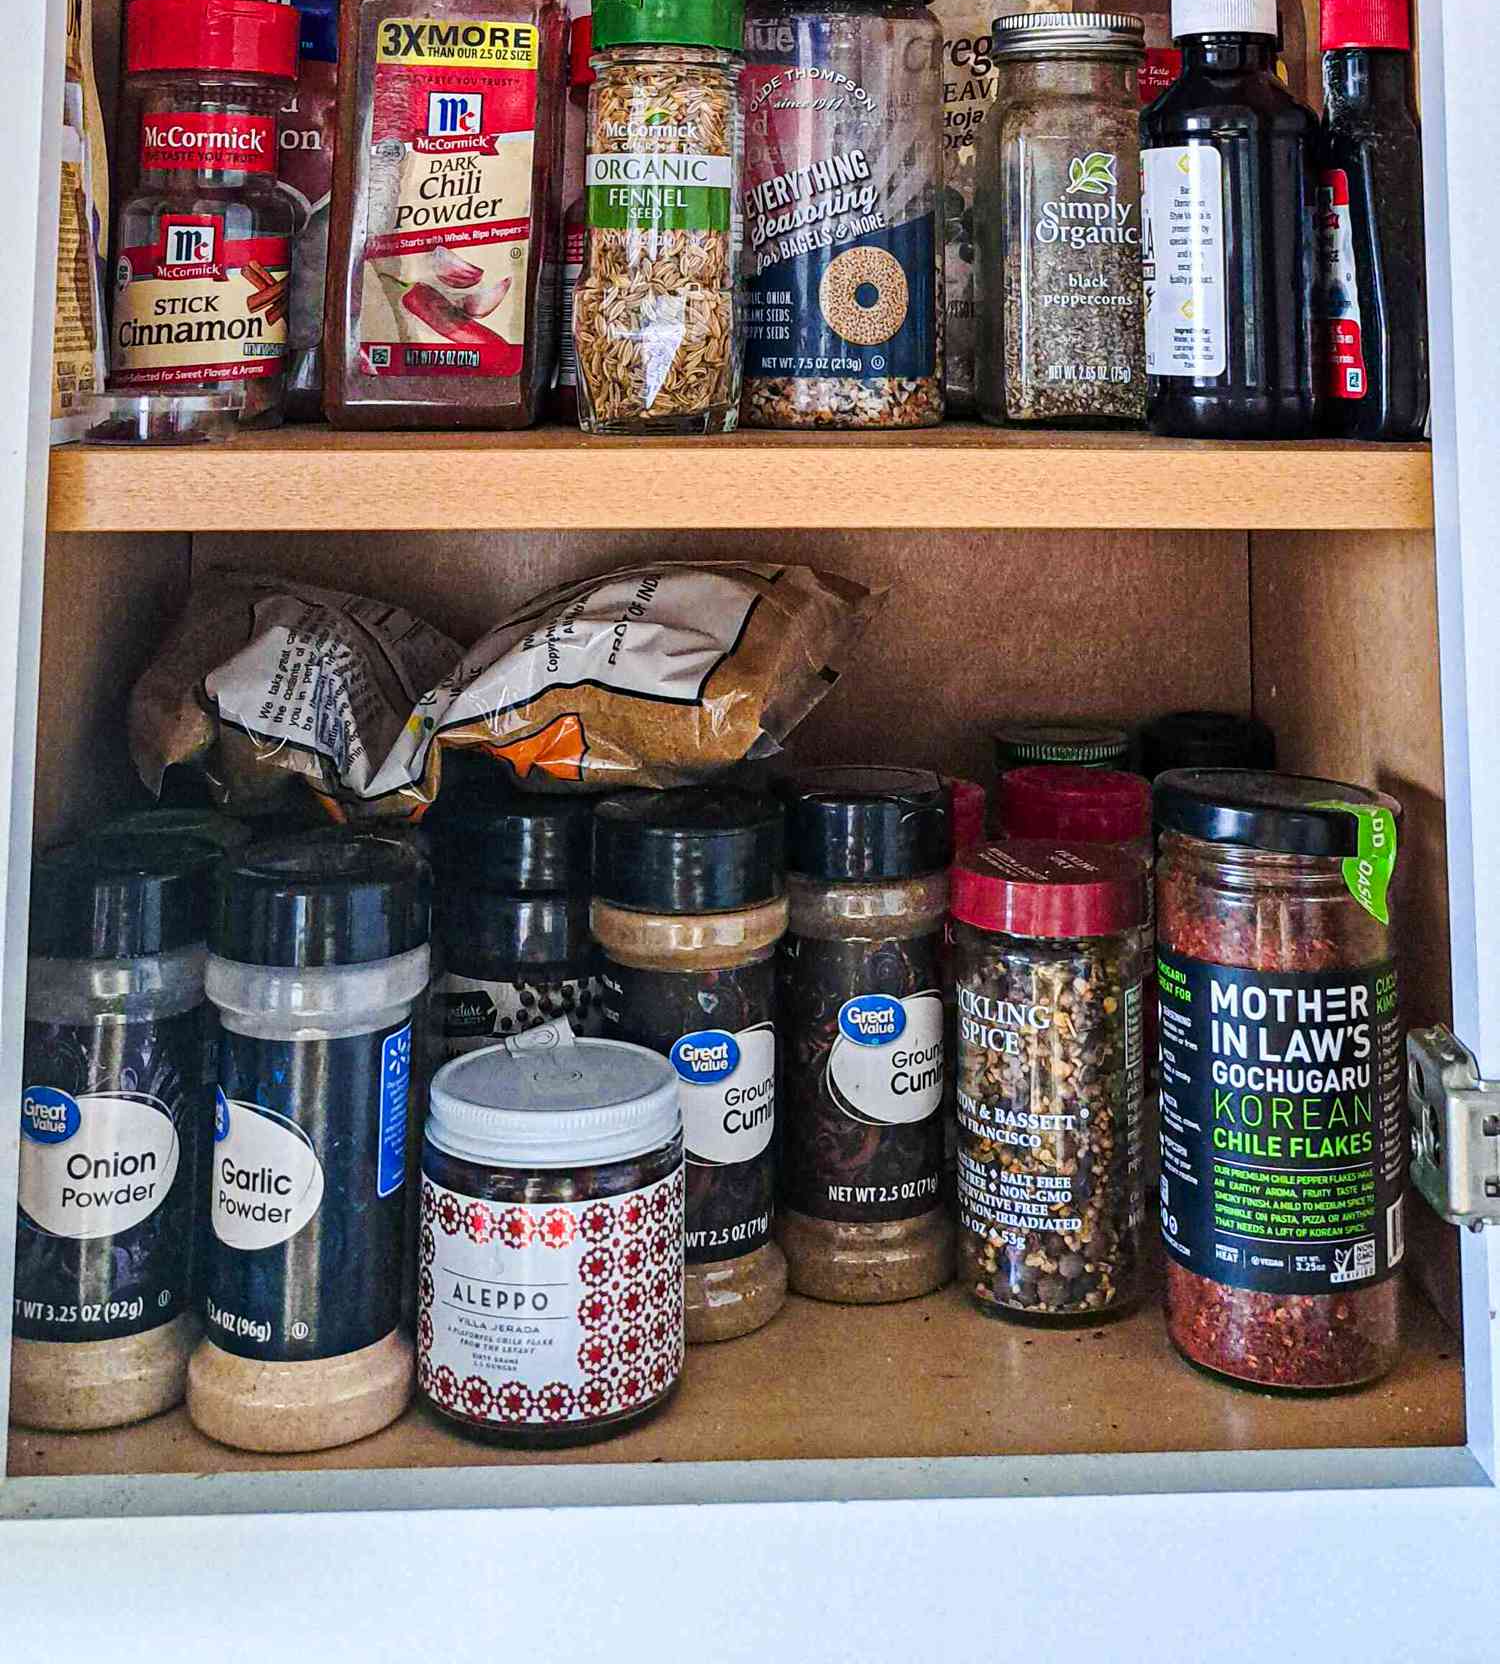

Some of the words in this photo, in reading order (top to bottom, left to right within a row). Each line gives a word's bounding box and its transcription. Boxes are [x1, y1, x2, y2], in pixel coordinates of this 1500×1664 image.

[382, 24, 426, 57] 3X
[428, 25, 532, 49] MORE
[427, 47, 455, 59] THAN
[457, 48, 477, 59] OUR
[480, 48, 494, 60] 2.5
[495, 49, 508, 60] OZ
[510, 50, 532, 62] SIZE
[750, 75, 783, 113] OLDE
[783, 66, 878, 113] THOMPSON
[773, 95, 811, 110] since
[145, 126, 266, 153] McCormick
[606, 121, 698, 138] McCormick
[416, 136, 490, 151] McCormick
[430, 155, 480, 174] DARK
[594, 159, 708, 182] ORGANIC
[419, 169, 483, 200] Chili
[744, 149, 871, 220] EVERYTHING
[608, 188, 689, 208] FENNEL
[393, 195, 503, 229] Powder
[629, 207, 663, 219] SEED
[752, 184, 880, 251] Seasoning
[1042, 195, 1132, 226] Simply
[400, 239, 425, 248] Starts
[490, 227, 522, 238] Peppers
[756, 248, 780, 276] for
[780, 226, 833, 260] BAGELS
[834, 223, 848, 239] &
[850, 212, 886, 238] MORE
[1035, 219, 1138, 250] Organic
[157, 264, 220, 278] McCormick
[1068, 273, 1108, 288] black
[154, 295, 220, 316] STICK
[766, 291, 794, 306] ONION,
[1043, 294, 1133, 307] peppercorns
[766, 309, 793, 323] SEEDS,
[119, 316, 263, 348] Cinnamon
[766, 326, 790, 340] SEEDS
[433, 350, 446, 365] 7.5
[446, 350, 457, 365] OZ
[761, 357, 778, 369] NET
[779, 357, 797, 369] WT.
[800, 358, 814, 369] 7.5
[815, 358, 829, 369] OZ
[831, 357, 862, 371] (213g)
[175, 369, 201, 380] Sweet
[232, 367, 238, 376] &
[628, 599, 647, 618] OF
[294, 689, 307, 702] in
[257, 700, 275, 721] We
[273, 704, 289, 724] the
[288, 706, 303, 728] you
[301, 714, 315, 733] be
[1175, 985, 1192, 1003] FOR
[1210, 979, 1370, 1023] MOTHER
[847, 1006, 895, 1025] Great
[858, 1022, 895, 1035] Value
[961, 1015, 1020, 1056] SPICE
[1211, 1019, 1248, 1060] IN
[1258, 1023, 1371, 1064] LAW'S
[679, 1042, 729, 1063] Great
[691, 1058, 729, 1073] Value
[1212, 1060, 1371, 1094] GOCHUGARU
[23, 1096, 68, 1122] Great
[979, 1103, 991, 1120] &
[994, 1107, 1076, 1131] BASSETT
[1214, 1088, 1374, 1131] KOREAN
[32, 1114, 67, 1134] Value
[967, 1117, 1042, 1148] FRANCISCO
[1213, 1127, 1283, 1158] CHILE
[1289, 1130, 1373, 1159] FLAKES
[66, 1151, 156, 1180] Onion
[1214, 1164, 1230, 1176] OUR
[1231, 1168, 1270, 1183] PREMIUM
[1270, 1174, 1296, 1185] CHILE
[1296, 1175, 1329, 1185] PEPPER
[220, 1157, 292, 1197] Garlic
[1000, 1170, 1034, 1188] SALT
[1036, 1175, 1072, 1189] FREE
[61, 1182, 157, 1209] Powder
[828, 1185, 854, 1202] NET
[855, 1186, 877, 1203] WT
[878, 1186, 898, 1202] 2.5
[901, 1182, 916, 1199] OZ
[999, 1185, 1072, 1203] NON-GMO
[1229, 1181, 1261, 1195] EARTHY
[1303, 1188, 1332, 1199] FRUITY
[219, 1190, 293, 1224] Powder
[969, 1199, 1082, 1231] NON-IRRADIATED
[1014, 1200, 1049, 1216] FREE
[1302, 1202, 1314, 1212] TO
[1214, 1215, 1234, 1229] THAT
[1234, 1220, 1265, 1234] NEEDS
[1266, 1226, 1273, 1235] A
[1274, 1227, 1295, 1236] LIFT
[1295, 1227, 1308, 1237] OF
[1308, 1227, 1344, 1238] KOREAN
[1302, 1214, 1327, 1225] PIZZA
[1328, 1213, 1340, 1224] OR
[685, 1231, 708, 1250] WT
[708, 1229, 729, 1247] 2.5
[730, 1223, 747, 1242] OZ
[747, 1211, 769, 1241] (71g)
[971, 1218, 988, 1237] OZ
[1000, 1229, 1026, 1250] 53g
[1215, 1249, 1239, 1264] HEAT
[451, 1281, 549, 1312] ALEPPO
[23, 1300, 45, 1320] WT
[45, 1303, 78, 1323] 3.25
[80, 1303, 101, 1323] OZ
[103, 1296, 144, 1324] (92g)
[221, 1311, 236, 1332] OZ
[235, 1315, 272, 1343] (96g)
[457, 1315, 488, 1332] VILLA
[489, 1323, 541, 1335] JERADA
